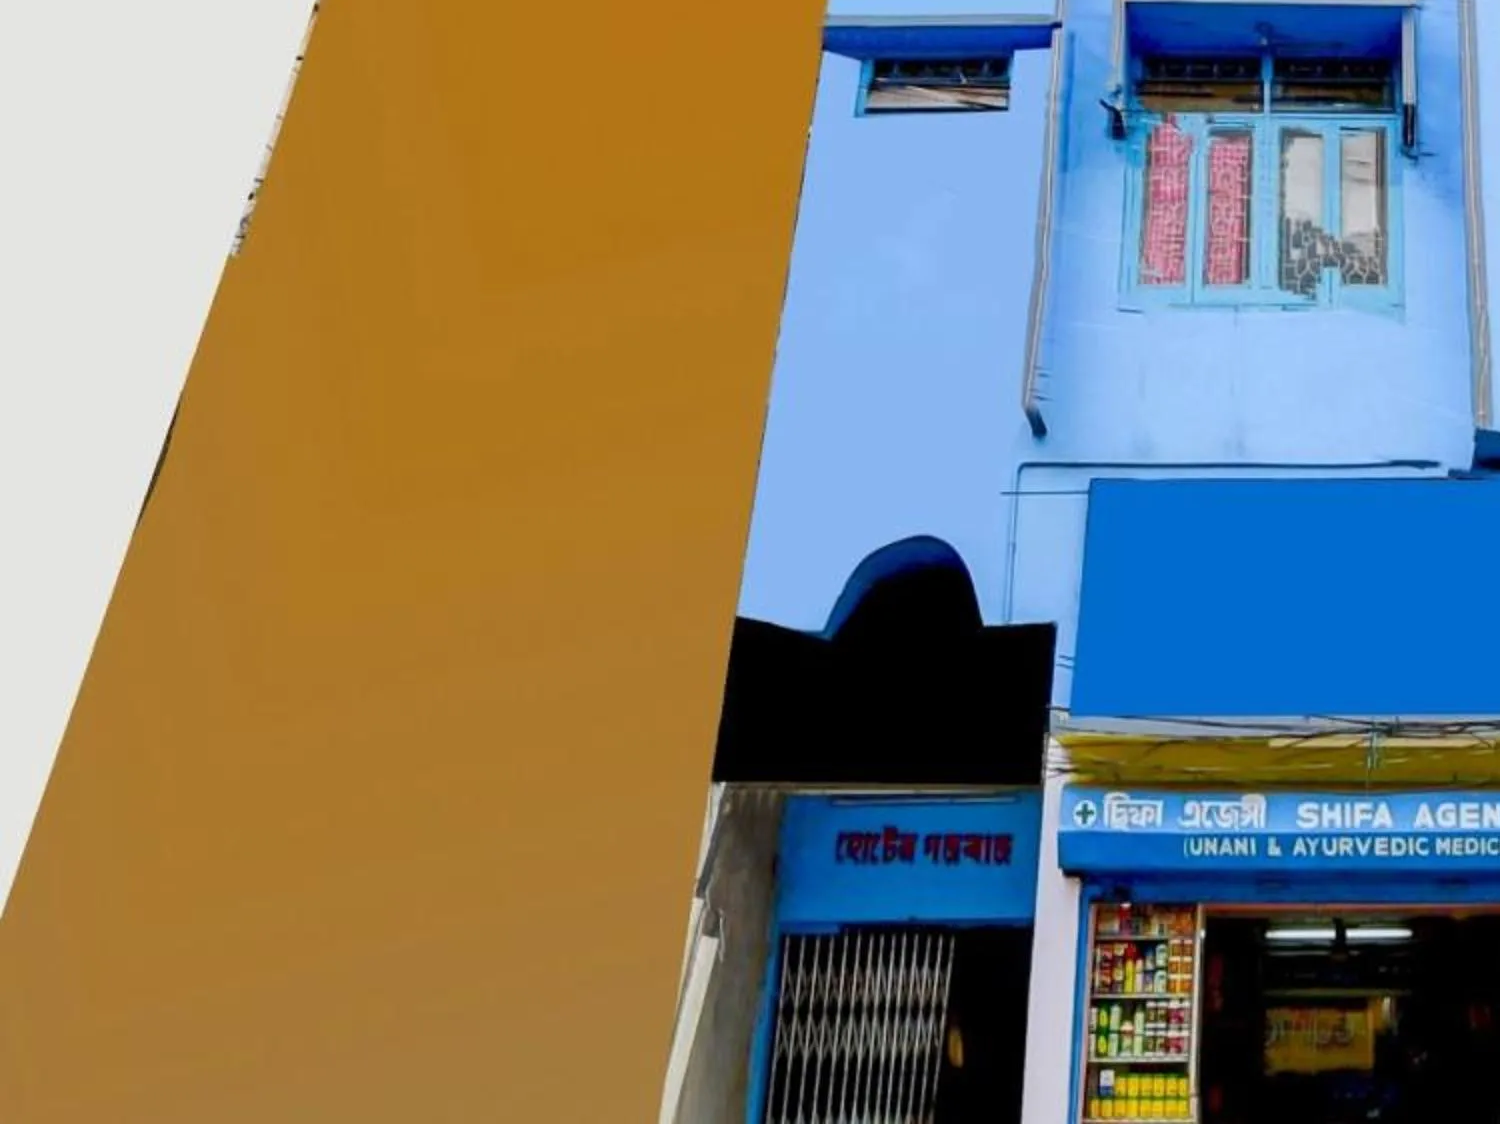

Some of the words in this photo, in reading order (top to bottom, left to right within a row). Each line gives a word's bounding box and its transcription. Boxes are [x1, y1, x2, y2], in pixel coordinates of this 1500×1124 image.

[1296, 801, 1394, 829] SHIFA
[1267, 837, 1283, 857] &
[1293, 836, 1430, 857] AYURVEDIC
